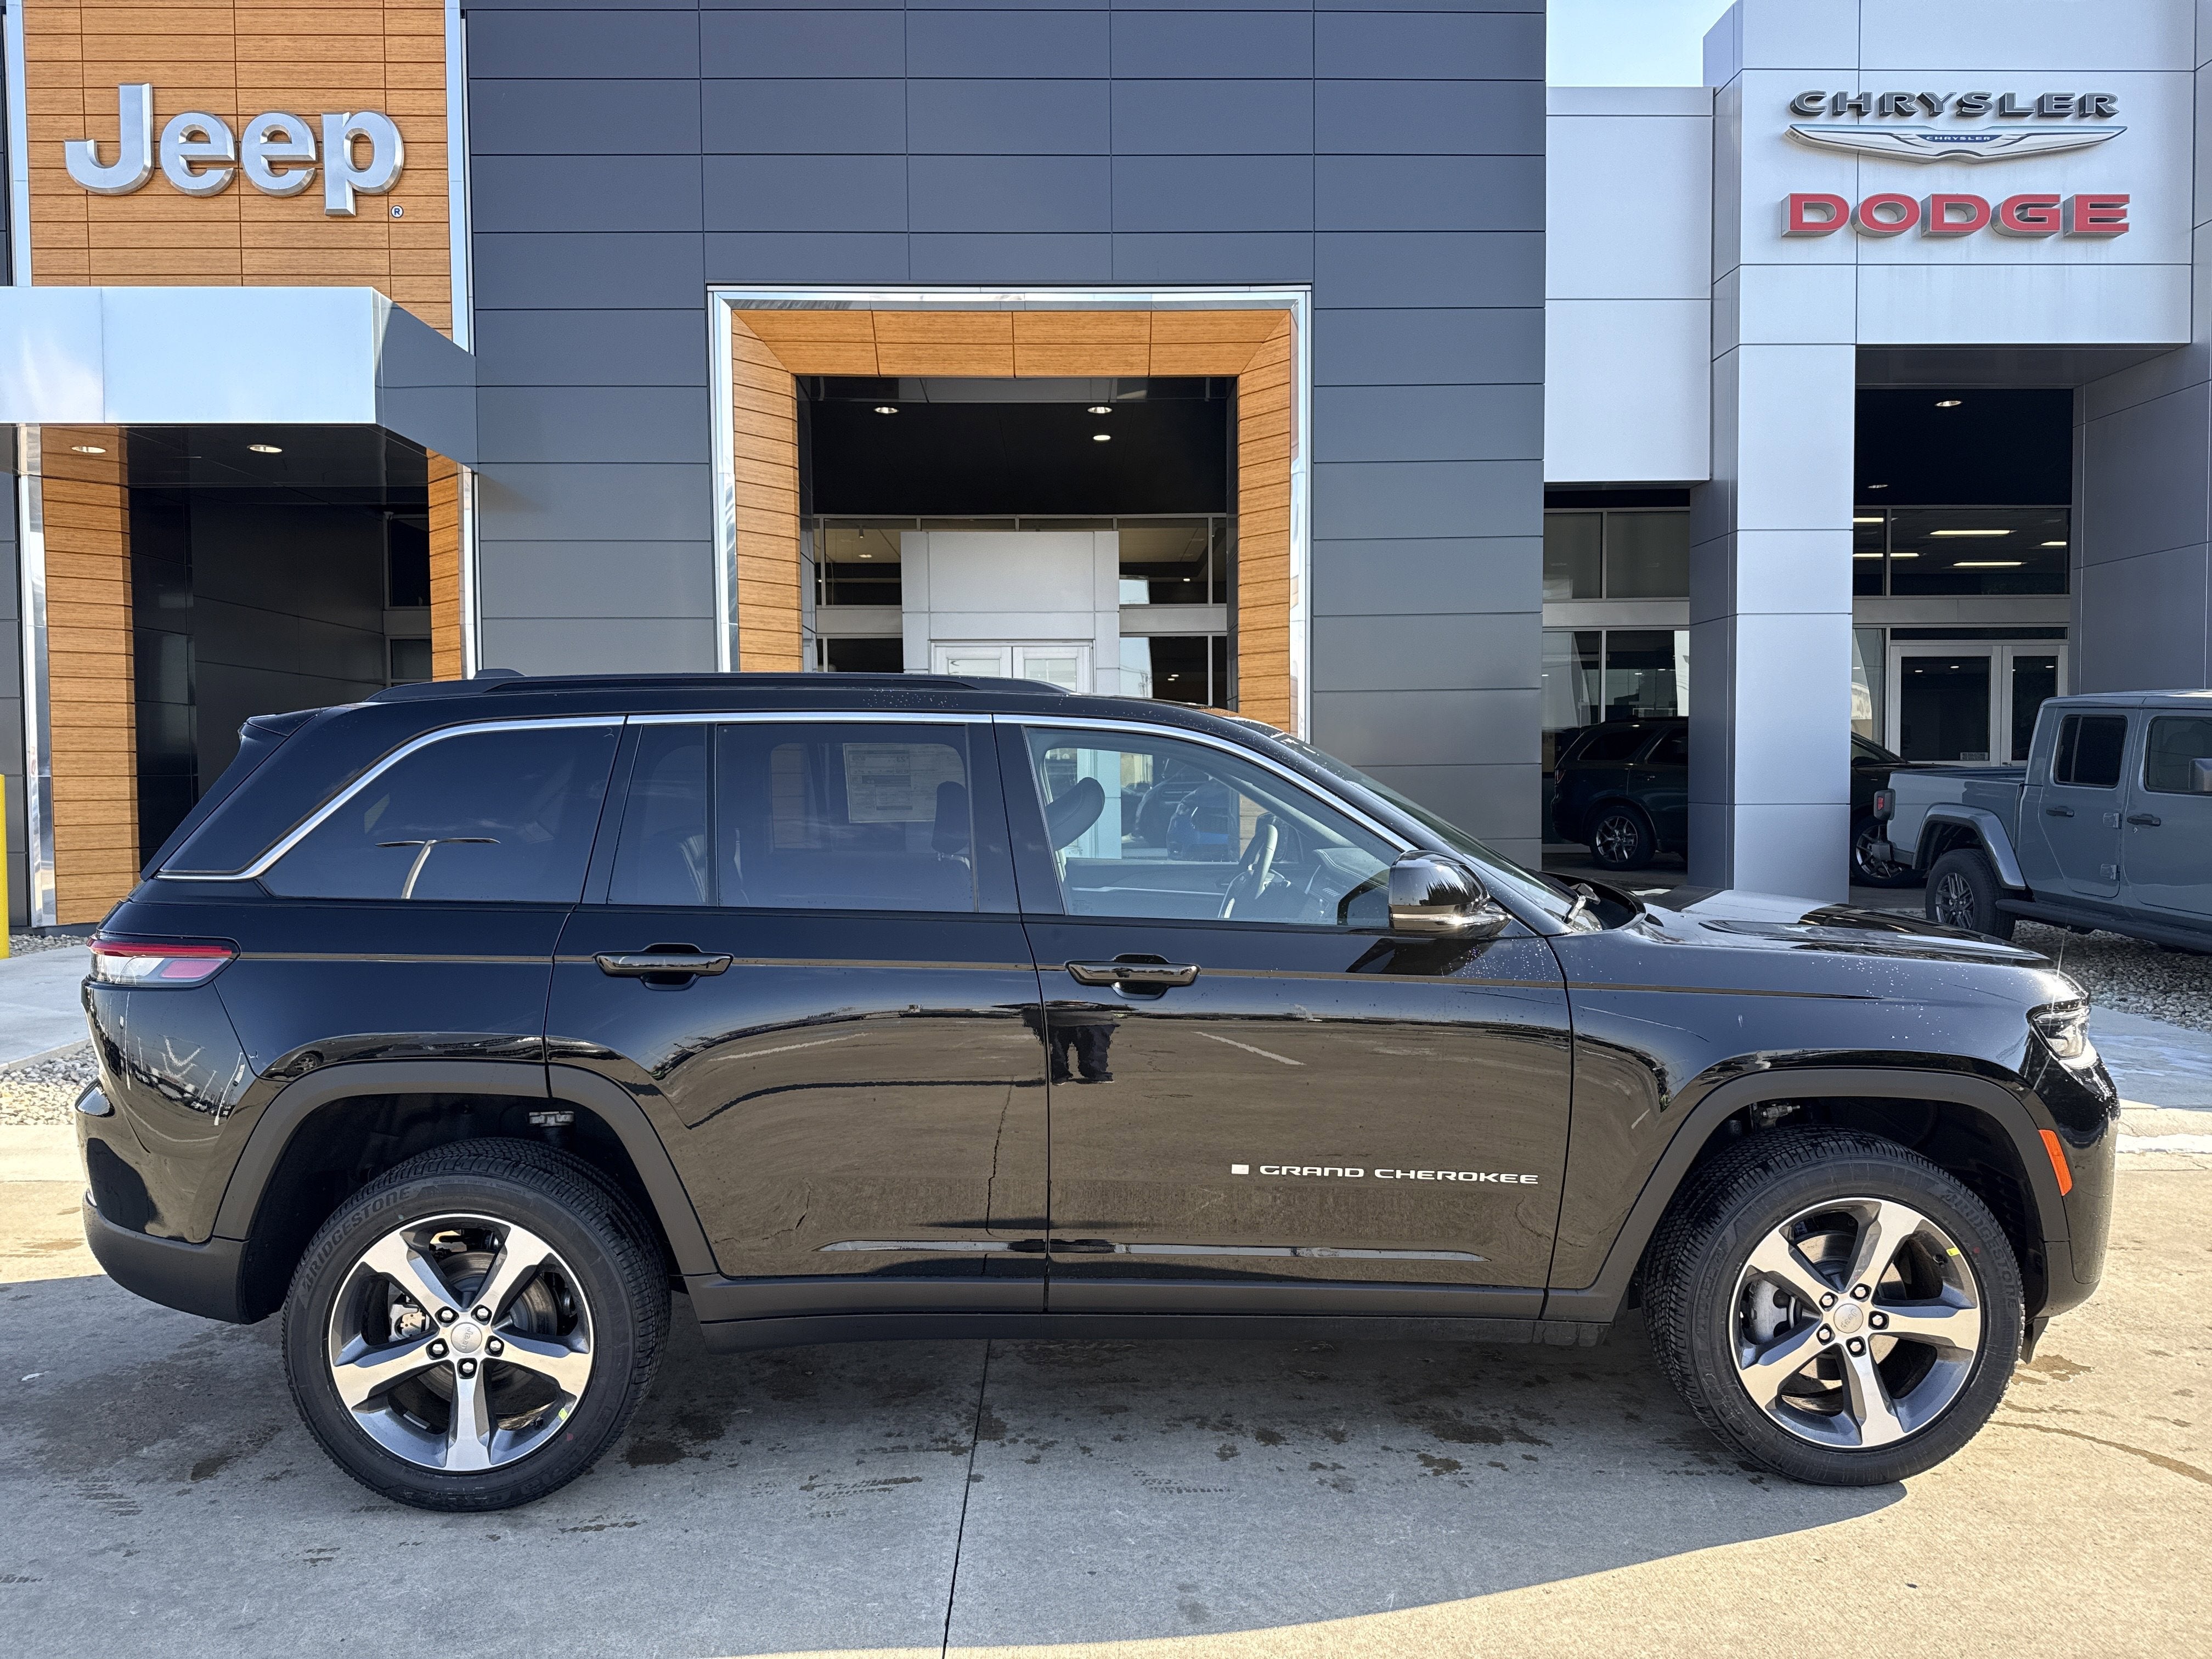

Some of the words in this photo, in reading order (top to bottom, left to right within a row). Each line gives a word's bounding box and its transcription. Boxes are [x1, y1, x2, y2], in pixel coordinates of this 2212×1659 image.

[1790, 91, 2119, 117] CHRYSLER
[63, 83, 404, 216] Jeep
[1781, 193, 2130, 237] DODGE
[1259, 1165, 1365, 1178] GRAND
[1374, 1169, 1538, 1184] CHEROKEE
[302, 1186, 411, 1291] BRIDGESTONE
[1940, 1189, 2017, 1309] BRIDGESTONE
[1840, 1308, 1858, 1330] Jeep
[459, 1326, 474, 1351] Jeep
